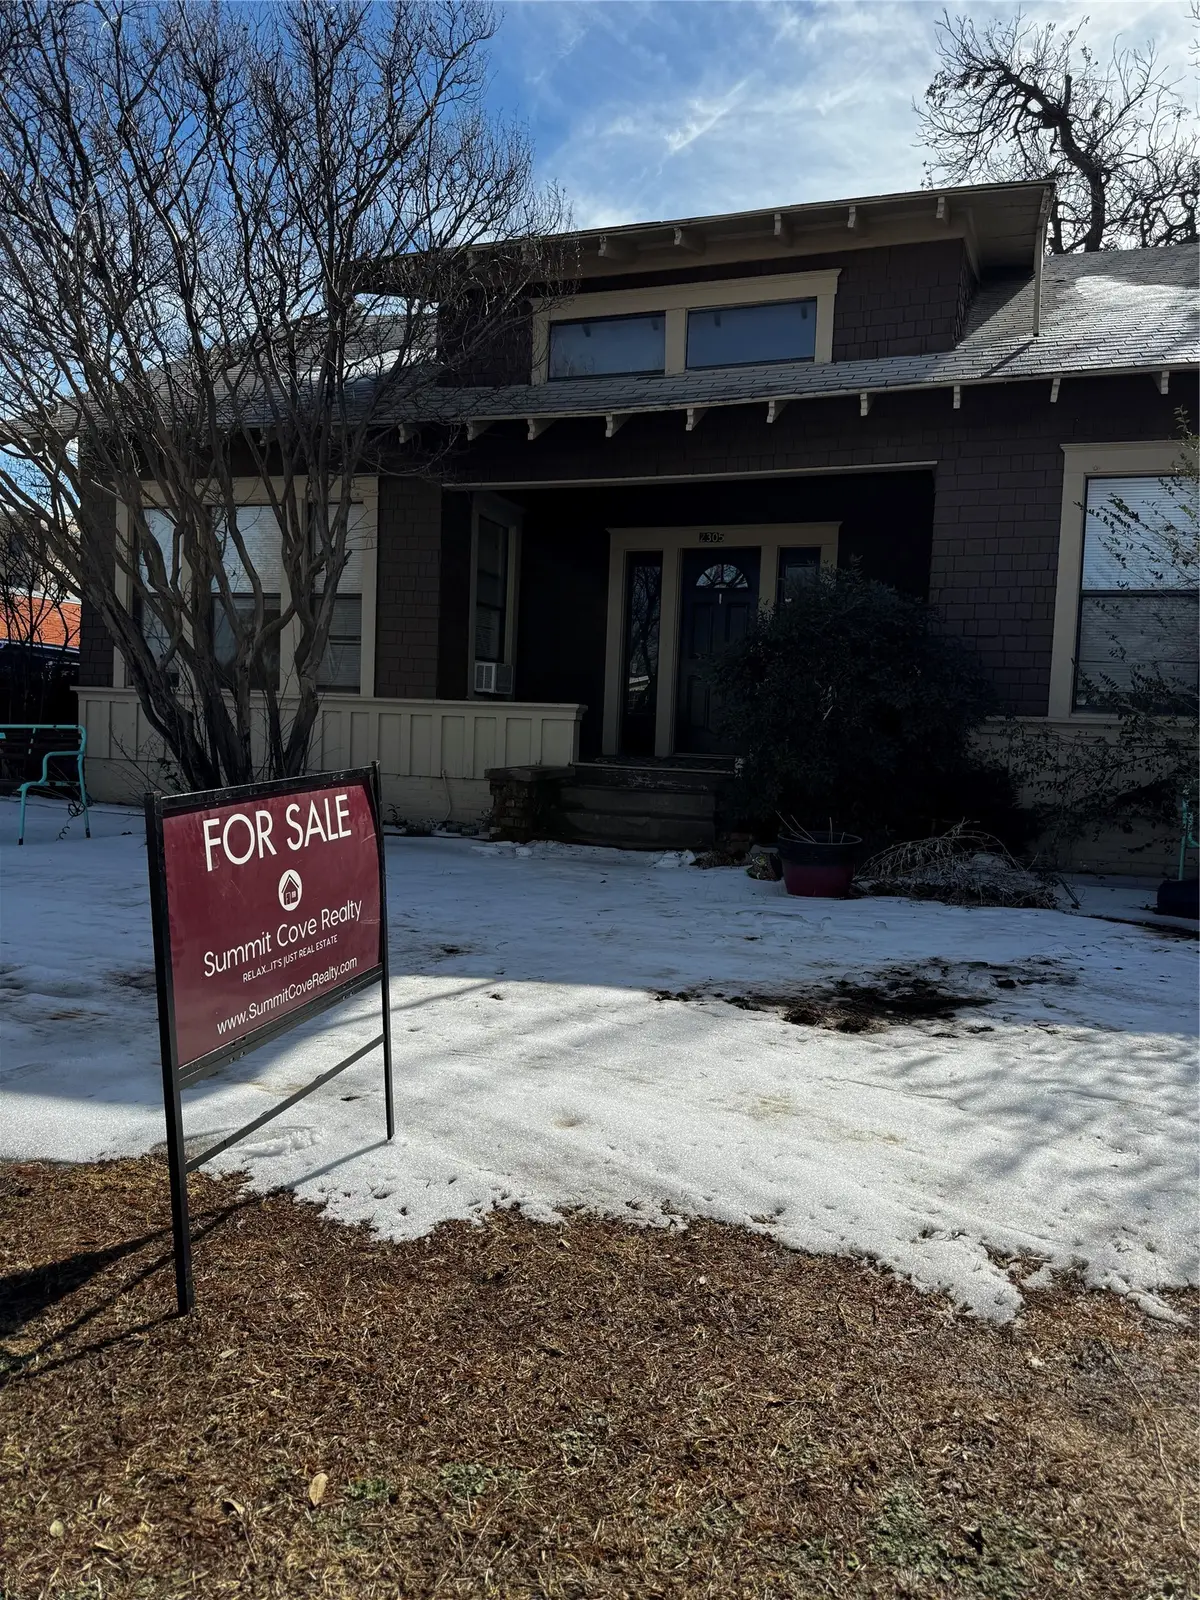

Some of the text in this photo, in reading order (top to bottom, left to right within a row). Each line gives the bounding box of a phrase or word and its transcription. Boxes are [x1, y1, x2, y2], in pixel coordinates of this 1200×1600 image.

[699, 532, 725, 543] 2305
[203, 794, 352, 872] FOR SALE
[204, 900, 362, 977] Summit Cove Realty
[283, 951, 298, 968] JUST
[298, 944, 315, 958] REAL
[315, 934, 338, 952] ESTATE
[217, 956, 358, 1035] www.SummitCoveRealty.com
